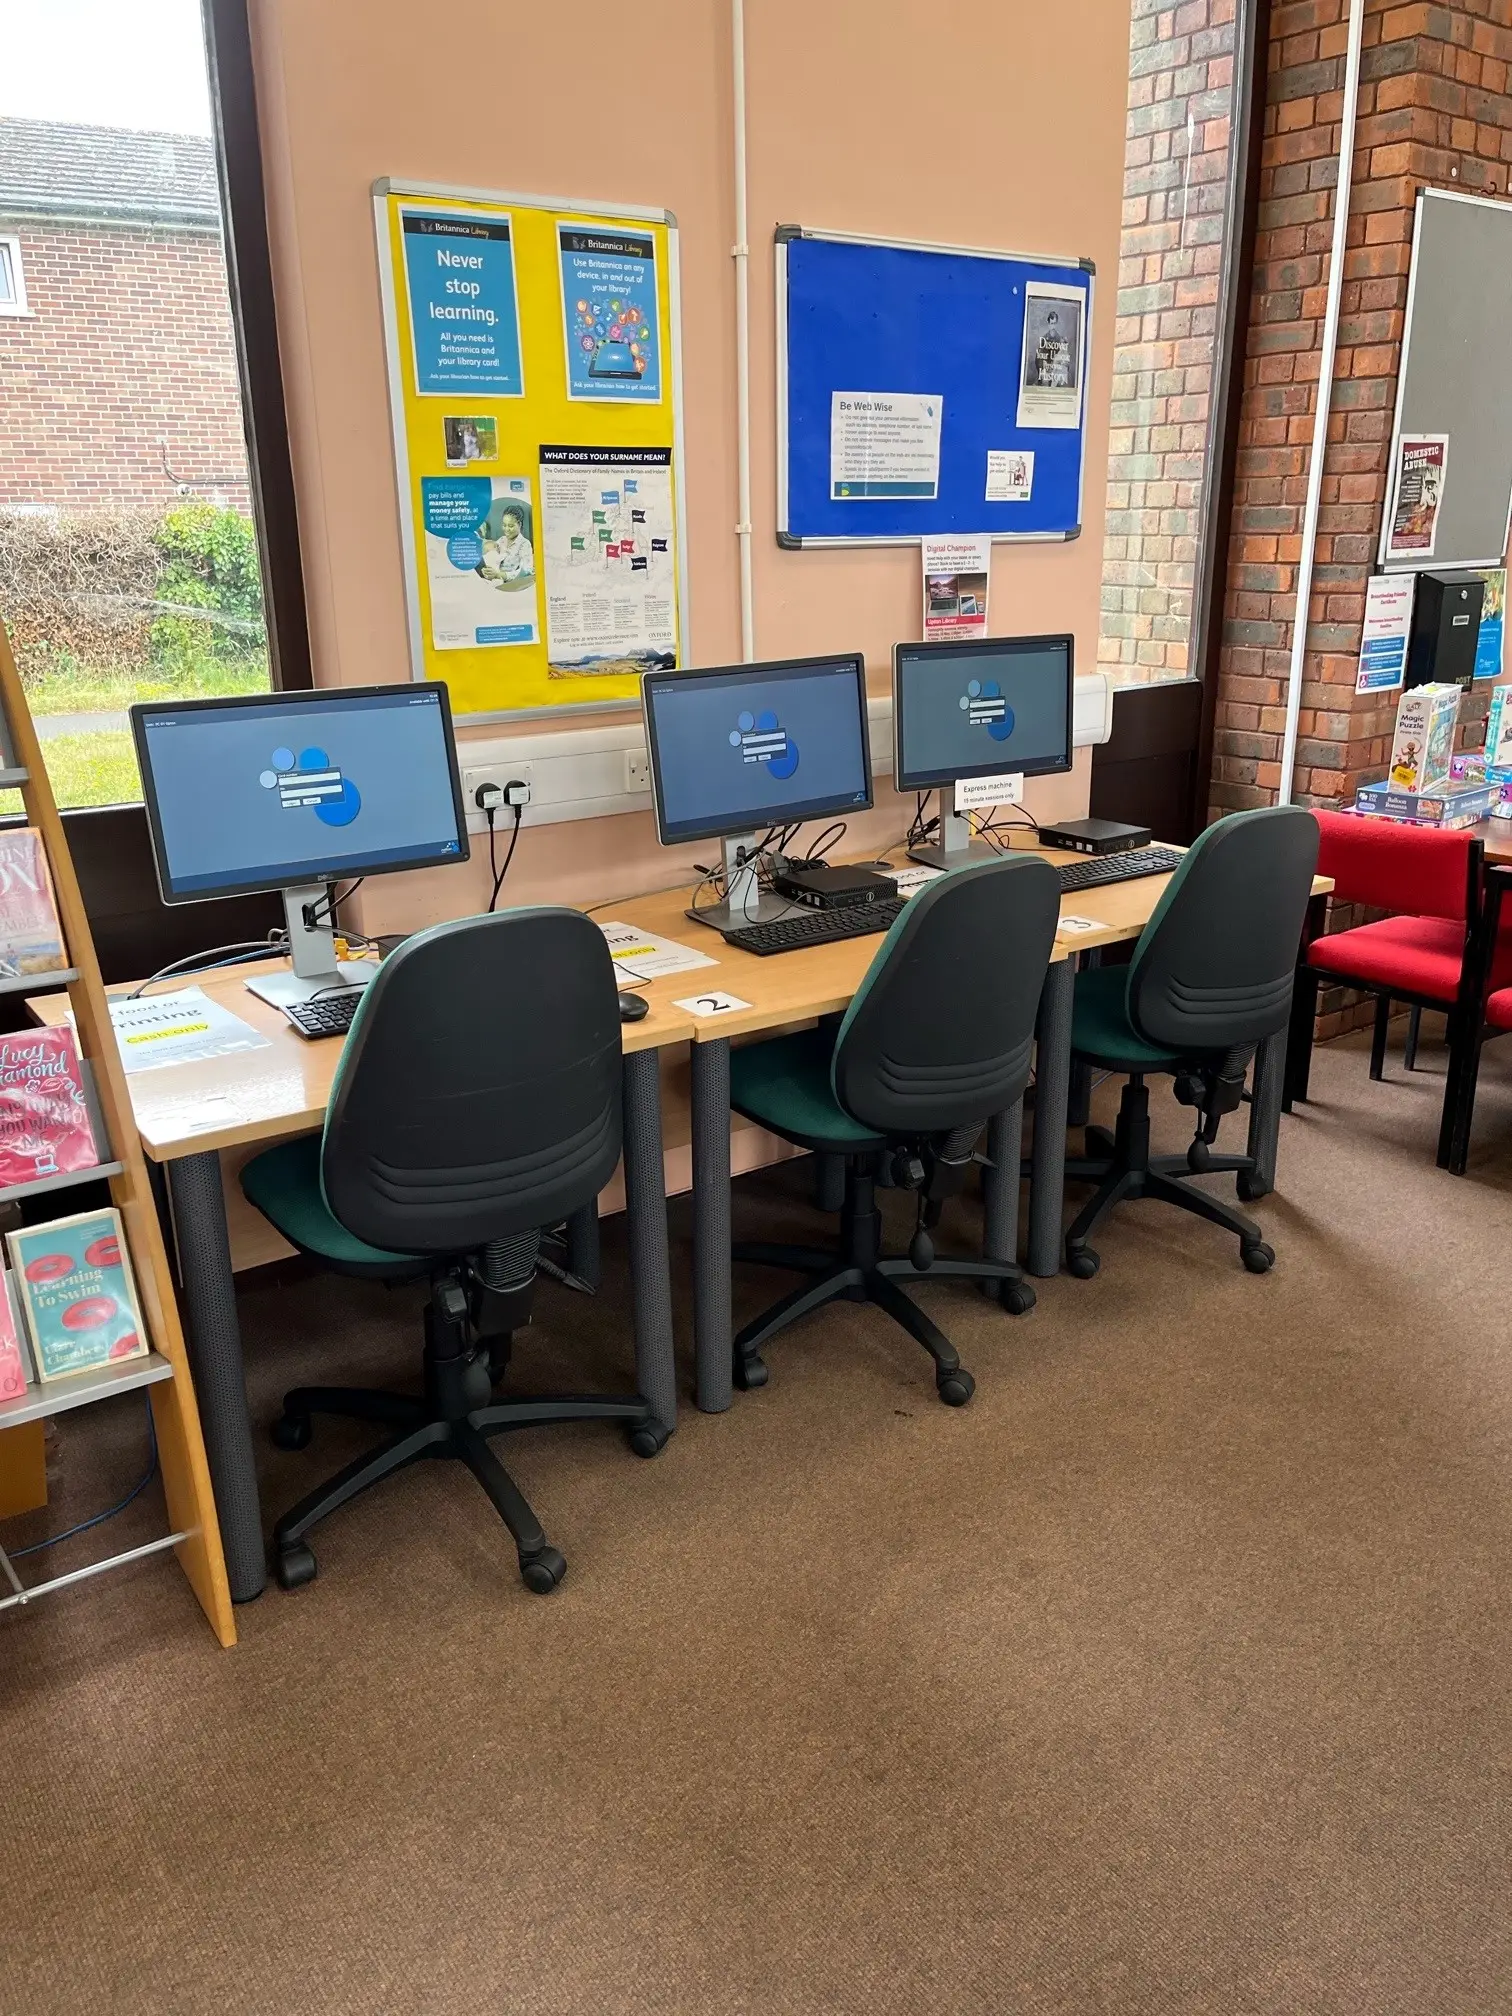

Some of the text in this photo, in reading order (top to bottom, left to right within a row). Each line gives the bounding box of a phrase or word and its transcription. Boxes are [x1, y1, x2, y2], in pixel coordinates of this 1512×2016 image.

[435, 223, 489, 240] Britannica Library
[588, 239, 643, 257] Britannica Library
[437, 249, 484, 270] Never
[573, 258, 587, 267] Use
[588, 259, 622, 270] Britannica
[633, 265, 645, 274] any
[602, 272, 609, 280] in
[610, 273, 623, 281] and
[624, 275, 635, 283] out
[636, 275, 643, 283] of
[446, 278, 480, 299] stop
[592, 284, 607, 293] your
[429, 301, 499, 326] learning.
[440, 333, 451, 341] All
[453, 334, 467, 343] you
[487, 335, 494, 343] is
[1039, 336, 1069, 351] Discover
[440, 344, 495, 354] Britannica and
[1035, 348, 1049, 360] Your
[438, 356, 500, 368] your library card!
[840, 401, 893, 412] Be Web Wise
[544, 452, 666, 461] WHAT DOES YOUR SURNAME MEAN?
[1404, 445, 1440, 461] DOMESTIC
[1403, 458, 1427, 471] ABUSE
[458, 522, 470, 530] you
[926, 544, 976, 554] Digital Champion
[1455, 675, 1471, 685] POST
[1399, 721, 1424, 729] Puzzle
[1400, 714, 1424, 723] Magic
[963, 781, 1013, 794] Express machine
[985, 793, 1004, 801] sessions
[1004, 792, 1015, 800] only
[1062, 919, 1092, 929] 3
[118, 1000, 180, 1016] food or
[696, 997, 732, 1012] 2
[113, 1008, 204, 1029] rinting
[126, 1023, 209, 1044] Cash only
[0, 1042, 57, 1070] Lucy
[0, 1050, 70, 1088] iamond
[32, 1268, 104, 1296] Learning
[36, 1283, 103, 1309] To Swim
